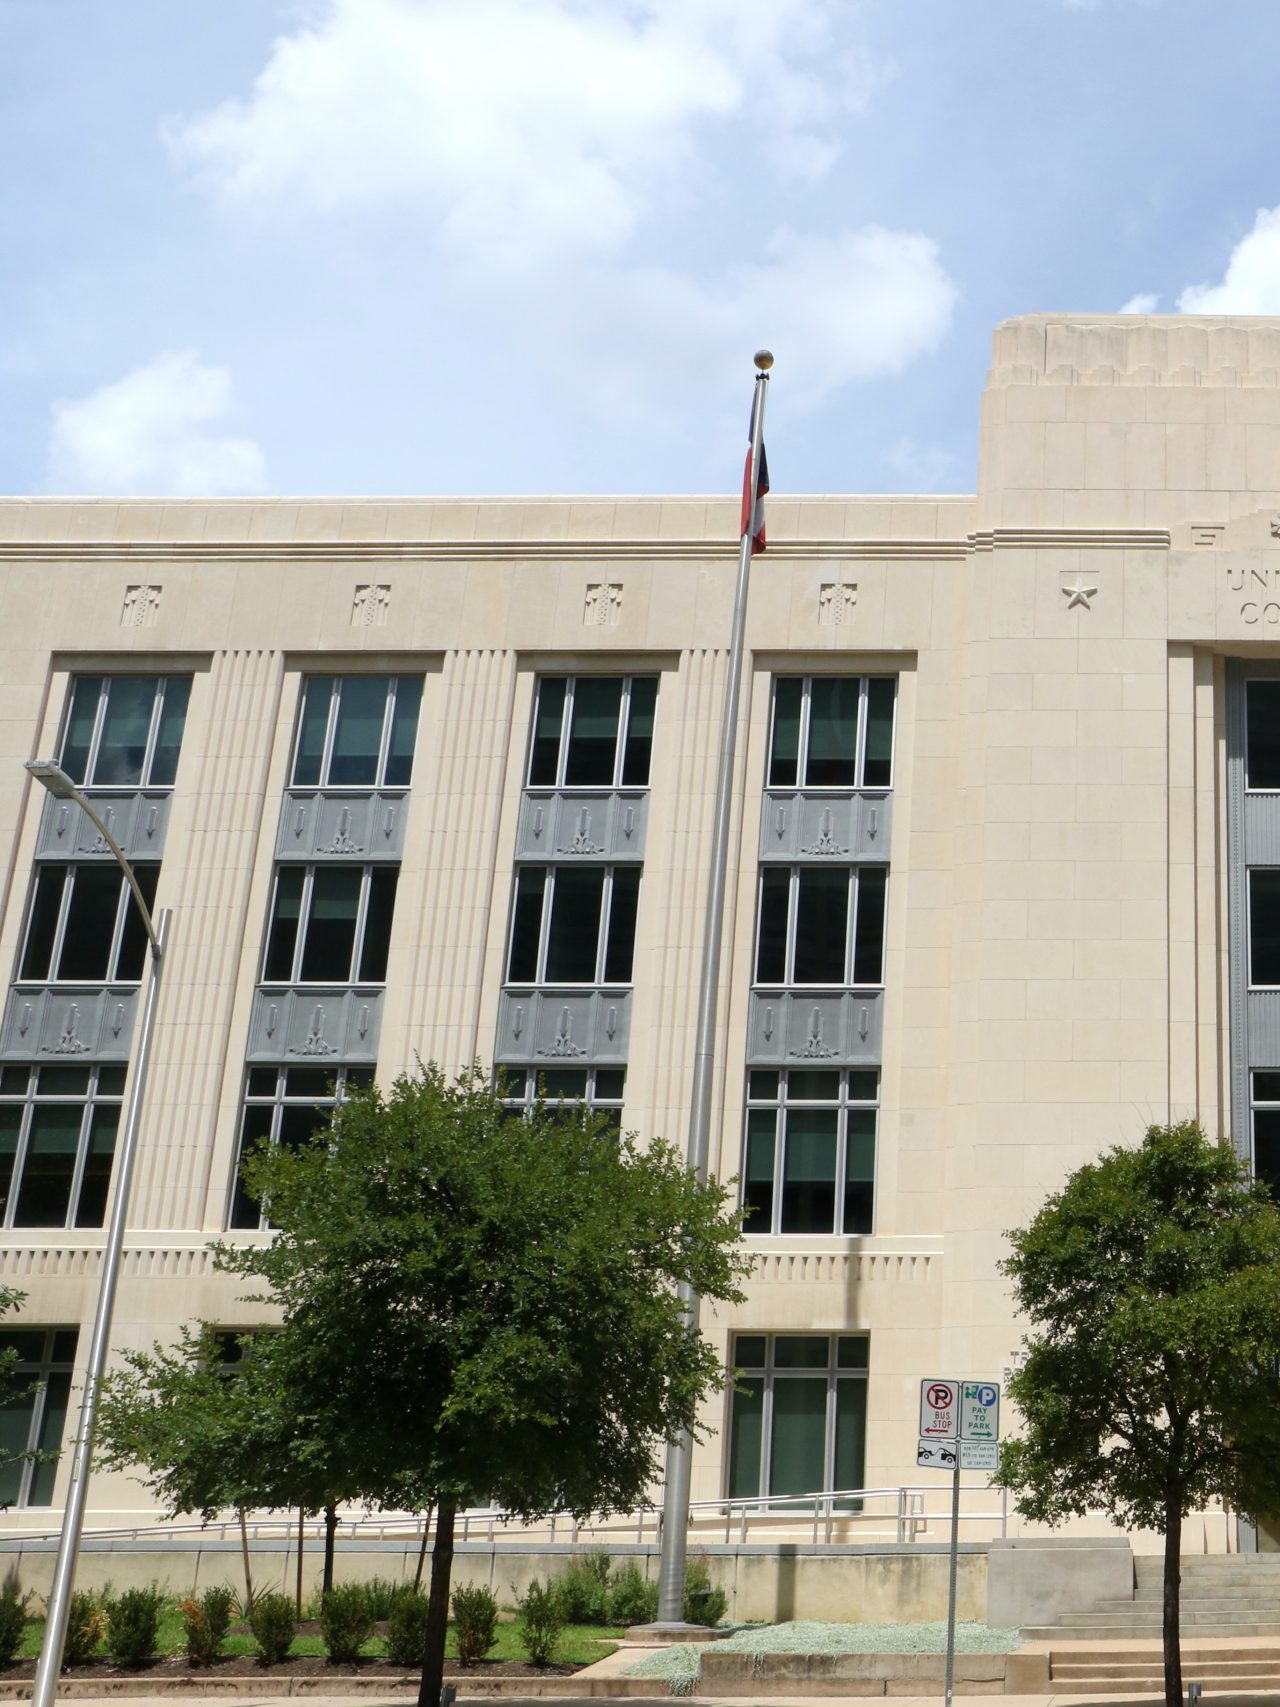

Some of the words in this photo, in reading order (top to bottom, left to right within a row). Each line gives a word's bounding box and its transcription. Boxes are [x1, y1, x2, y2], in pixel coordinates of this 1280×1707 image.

[981, 1389, 994, 1405] P
[972, 1406, 988, 1414] PAY
[935, 1411, 950, 1420] BUS
[932, 1420, 952, 1429] STOP
[968, 1422, 991, 1430] PARK
